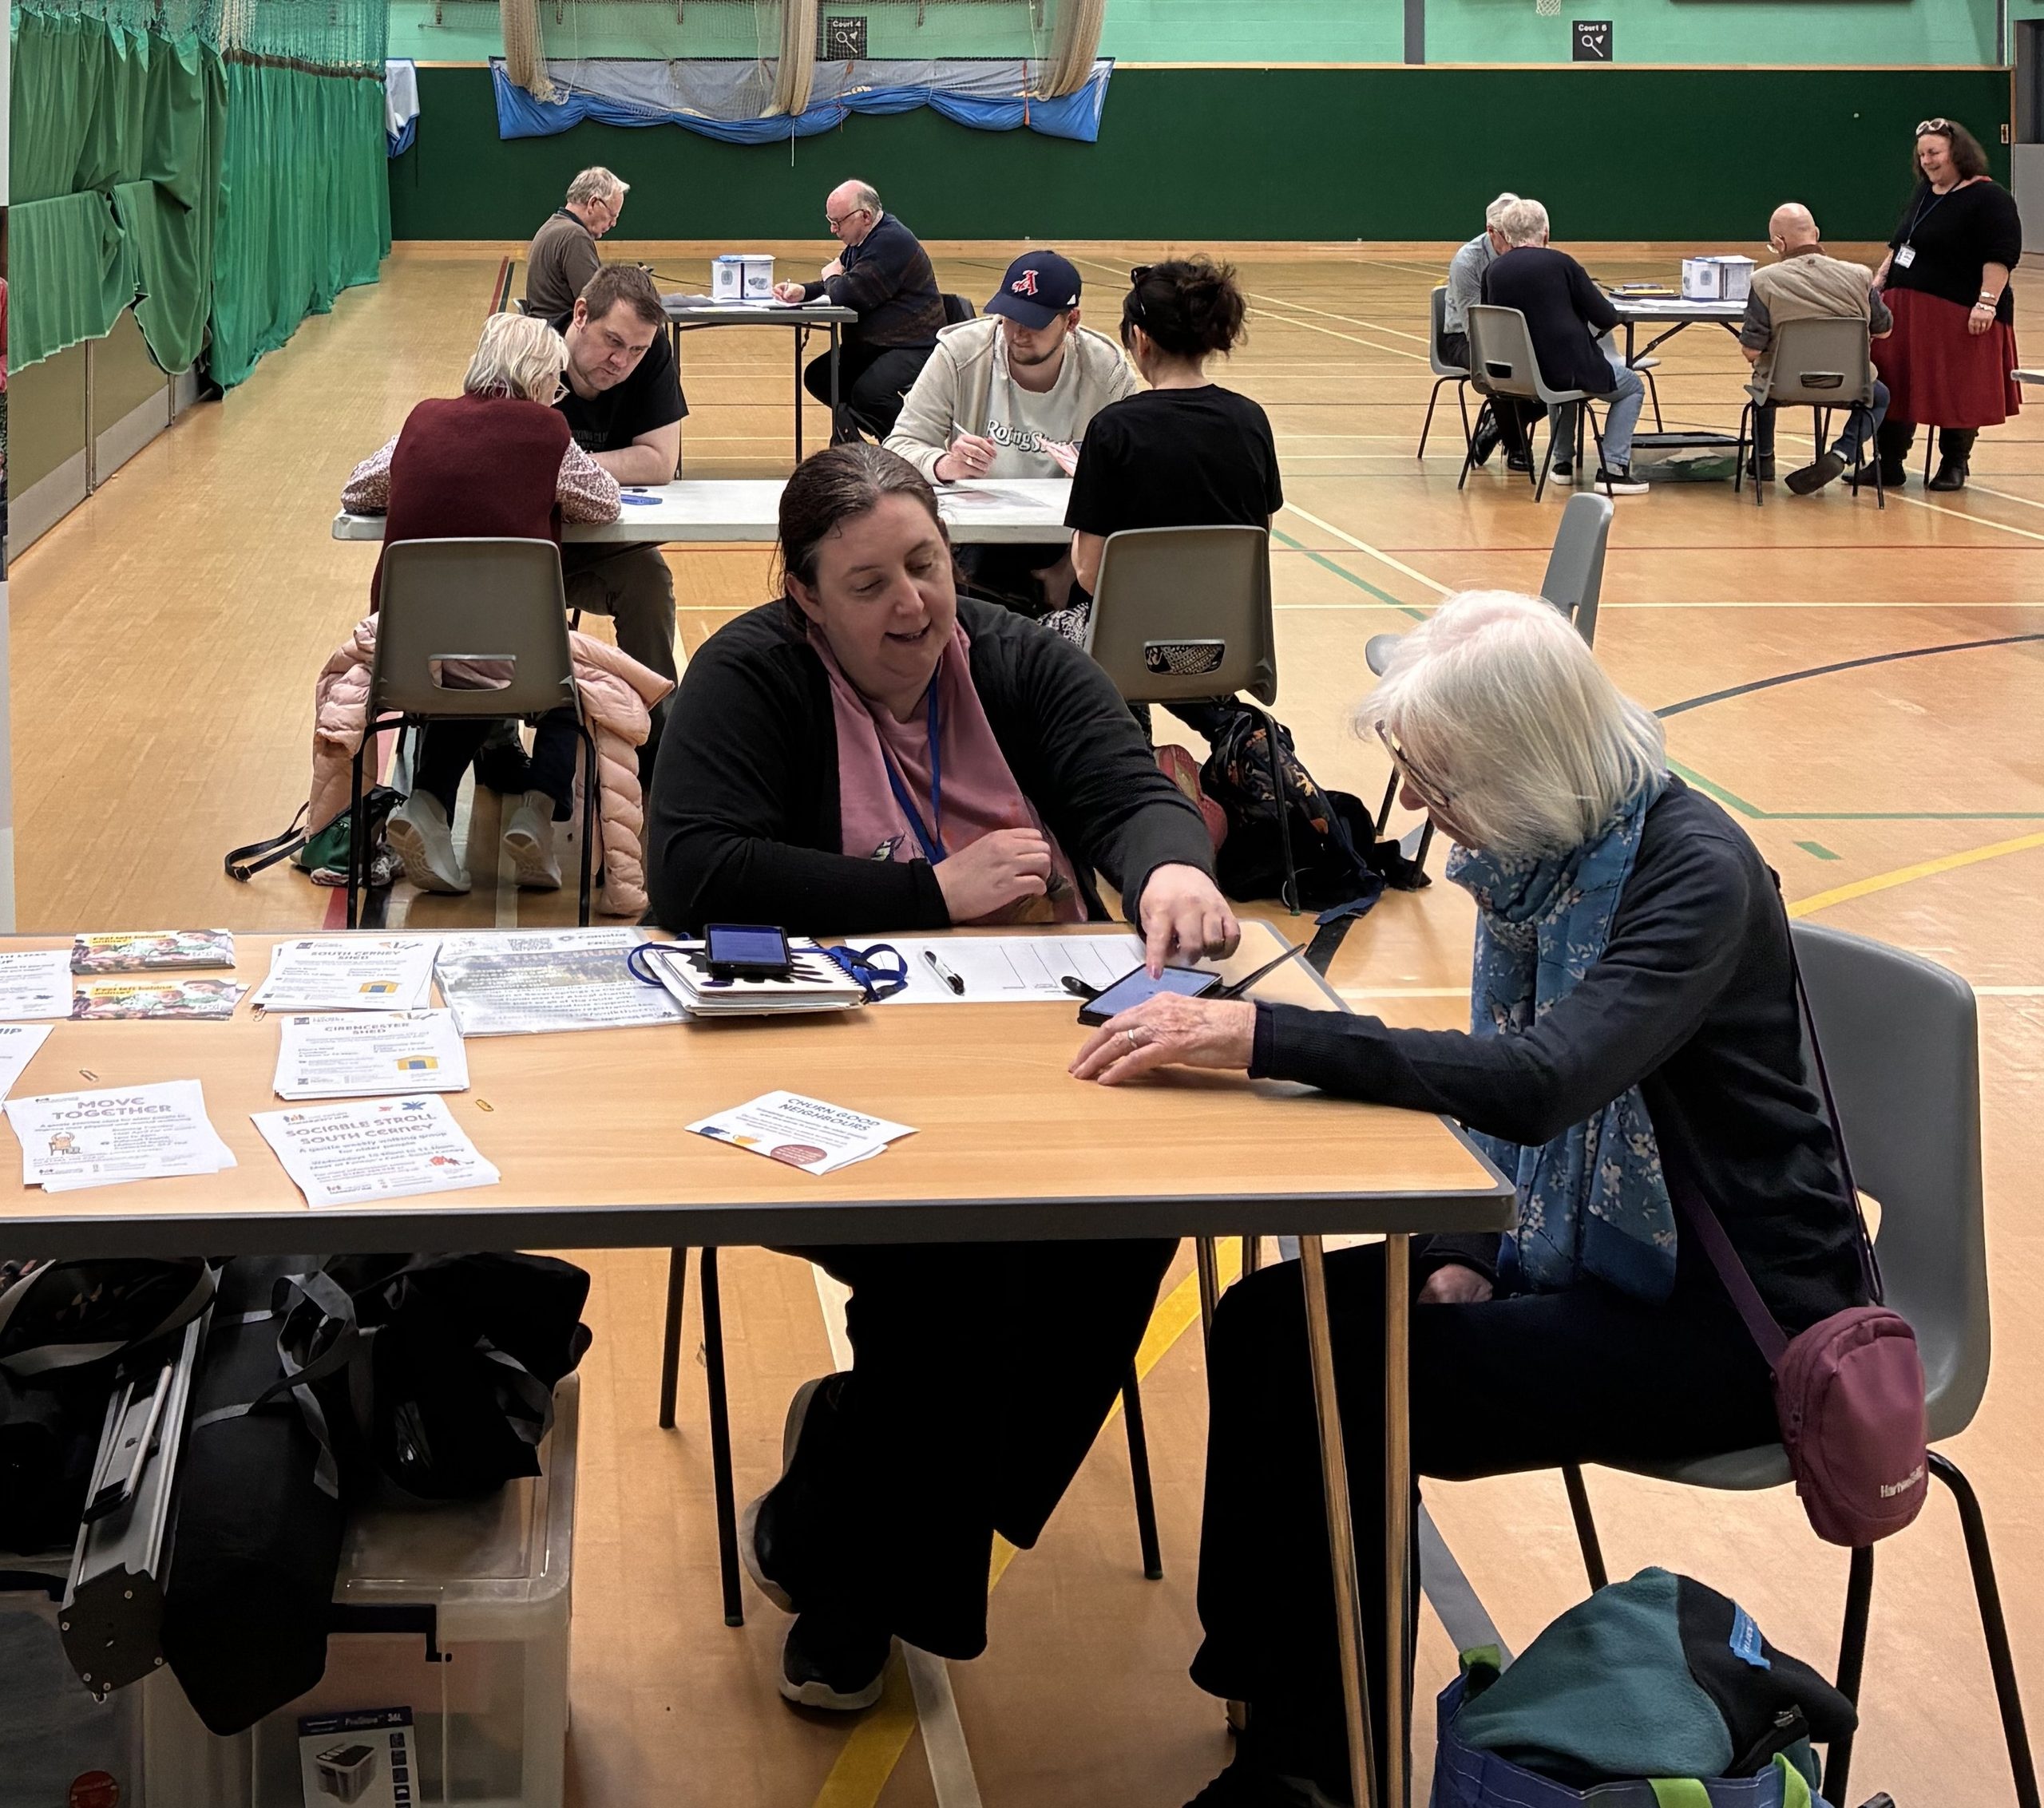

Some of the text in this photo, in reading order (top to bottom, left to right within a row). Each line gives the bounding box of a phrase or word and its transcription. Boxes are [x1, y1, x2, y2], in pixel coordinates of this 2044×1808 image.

[52, 1105, 172, 1120] TOGETHER
[77, 1097, 145, 1109] MOVE
[787, 1098, 881, 1126] CHURN GOOD
[286, 1114, 437, 1137] SOCIABLE STROLL
[778, 1104, 871, 1131] NEIGHBOURS
[300, 1123, 434, 1145] SOUTH CERNEY
